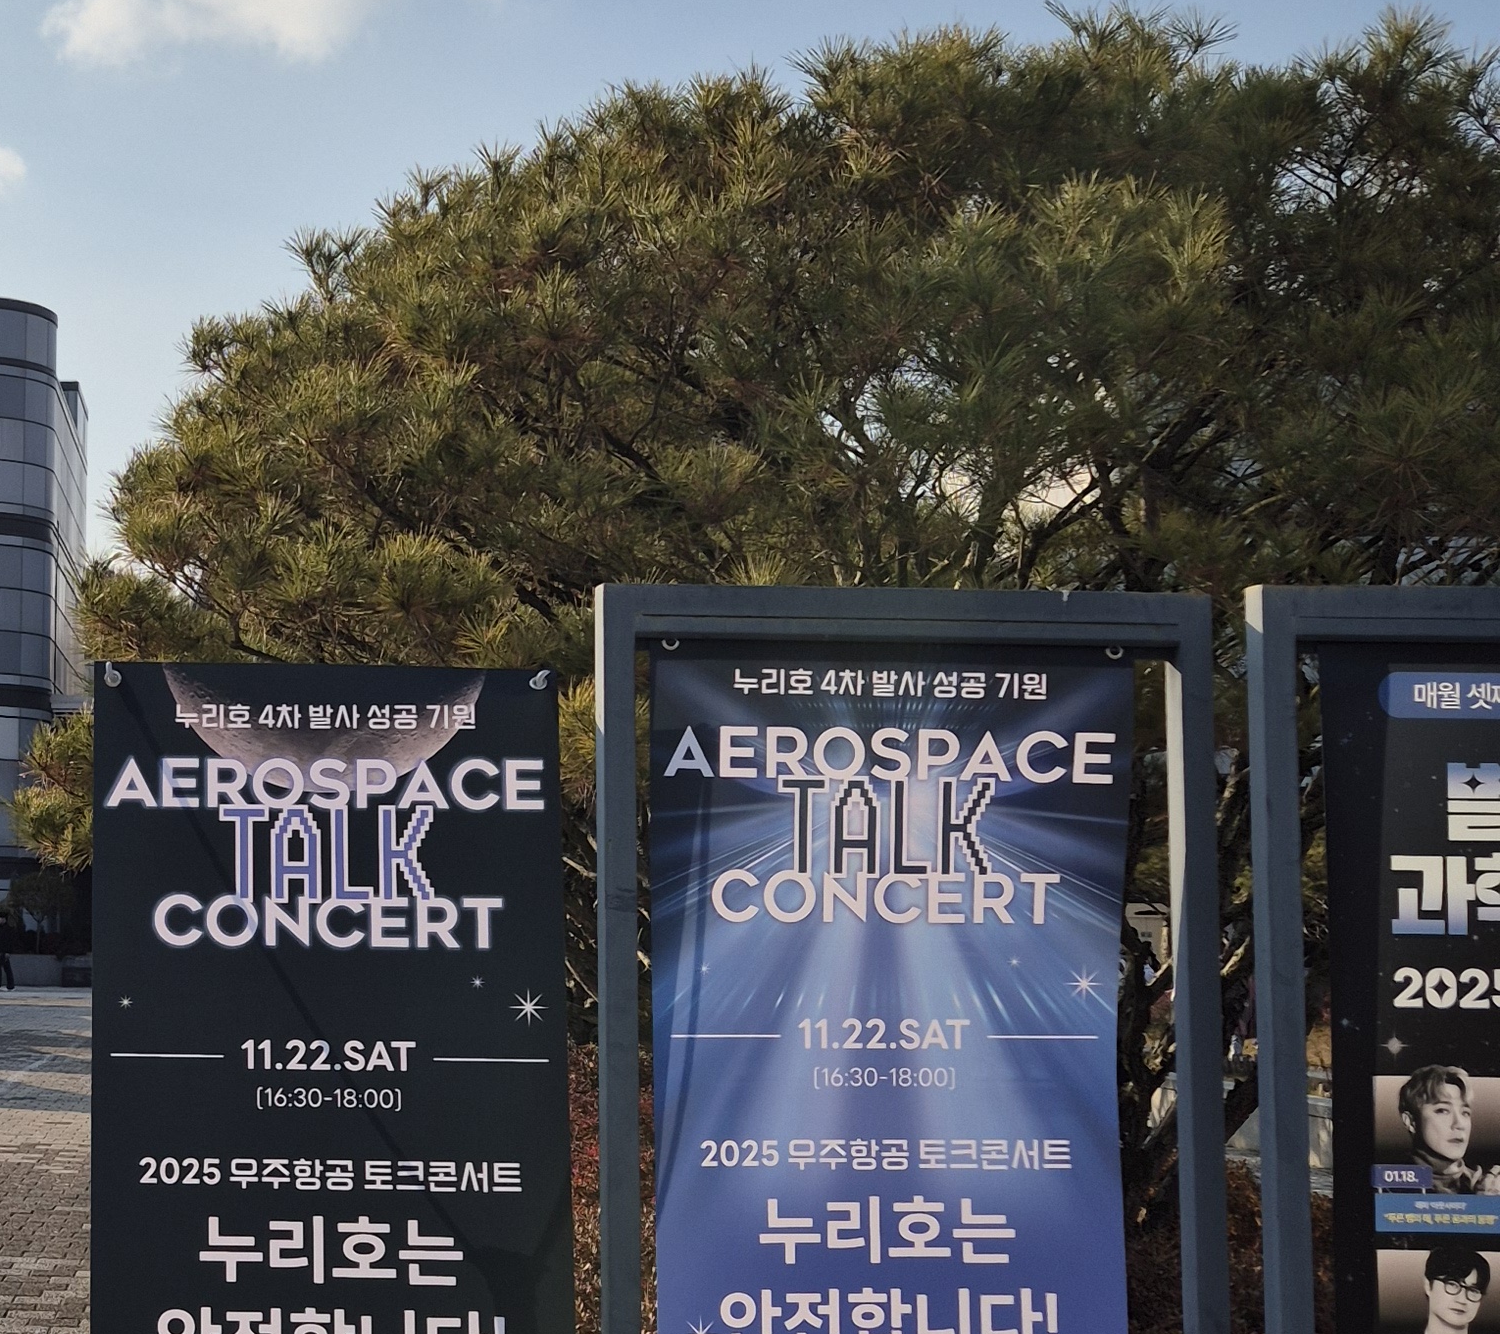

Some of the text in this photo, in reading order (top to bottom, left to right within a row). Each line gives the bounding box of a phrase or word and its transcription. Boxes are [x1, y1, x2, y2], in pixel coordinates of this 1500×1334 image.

[734, 669, 1048, 700] 누리호 4차 발사 성공 기원
[1414, 682, 1460, 709] 매월
[175, 704, 477, 730] 누리호 4차 발사 성공 기원
[663, 725, 1118, 785] AEROSPACE
[104, 756, 545, 811] AEROSPACE
[777, 775, 995, 876] TALK
[216, 805, 437, 904] TALK
[151, 893, 506, 950] CONCERT
[711, 869, 1061, 925] CONCERT
[241, 1040, 416, 1071] 11.22.SAT
[798, 1018, 971, 1051] 11.22.SAT
[139, 1157, 522, 1192] 2025 우주항공 토크콘서트
[701, 1139, 1071, 1170] 2025 우주항공 토크콘서트
[200, 1216, 463, 1285] 누리호는
[759, 1196, 1015, 1264] 누리호는
